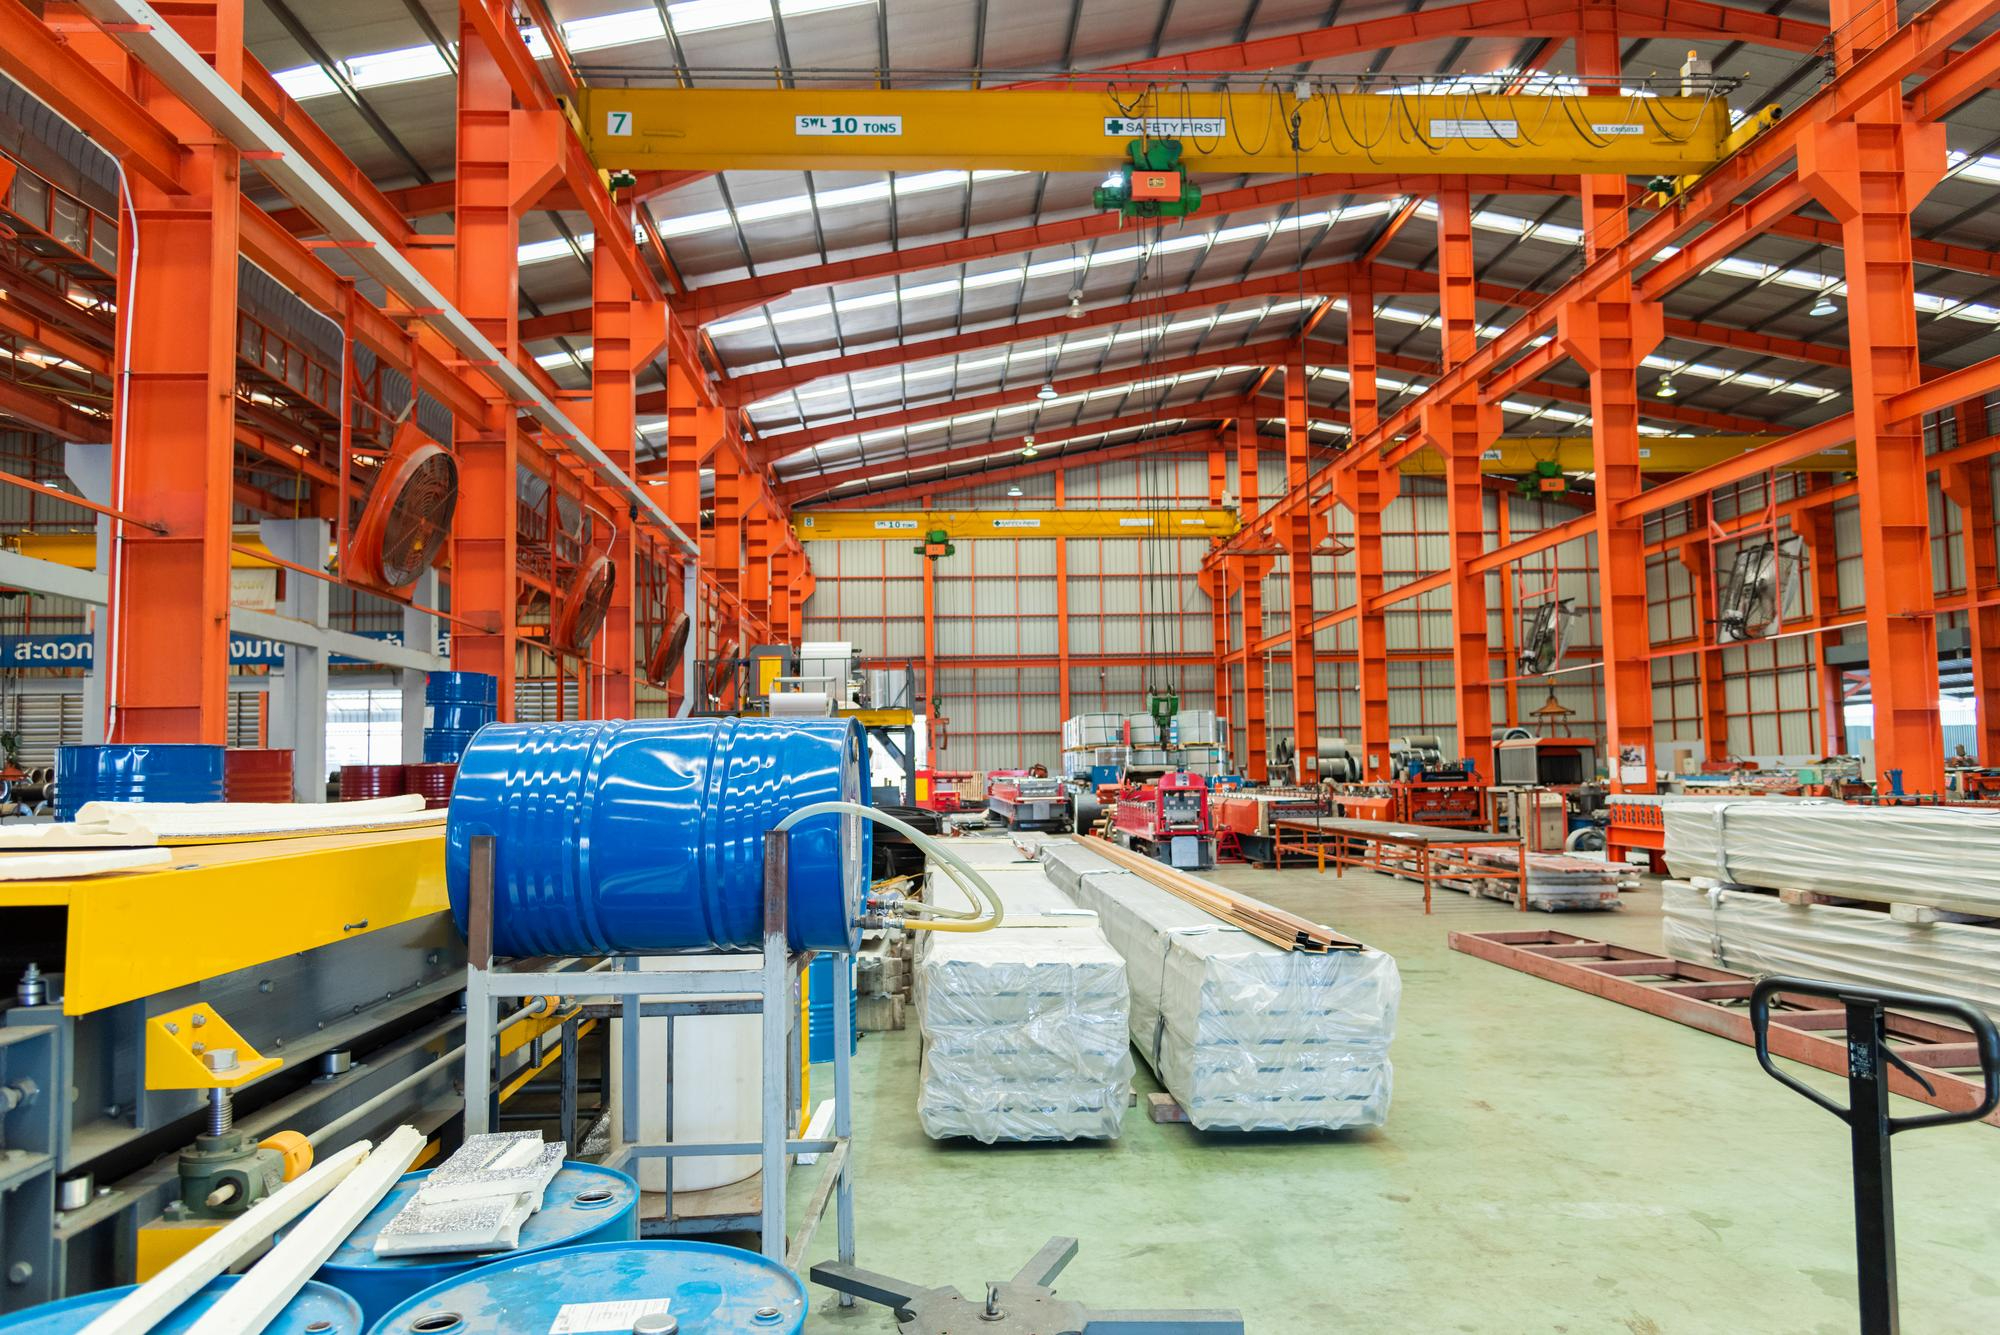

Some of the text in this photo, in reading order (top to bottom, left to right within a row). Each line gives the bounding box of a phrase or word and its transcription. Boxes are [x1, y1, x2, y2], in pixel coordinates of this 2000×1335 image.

[612, 113, 627, 134] 7
[801, 117, 897, 134] SWL 10 TONS
[1126, 123, 1221, 133] SAFETY FIRST
[806, 518, 812, 526] 8
[14, 641, 93, 661] สะดวก
